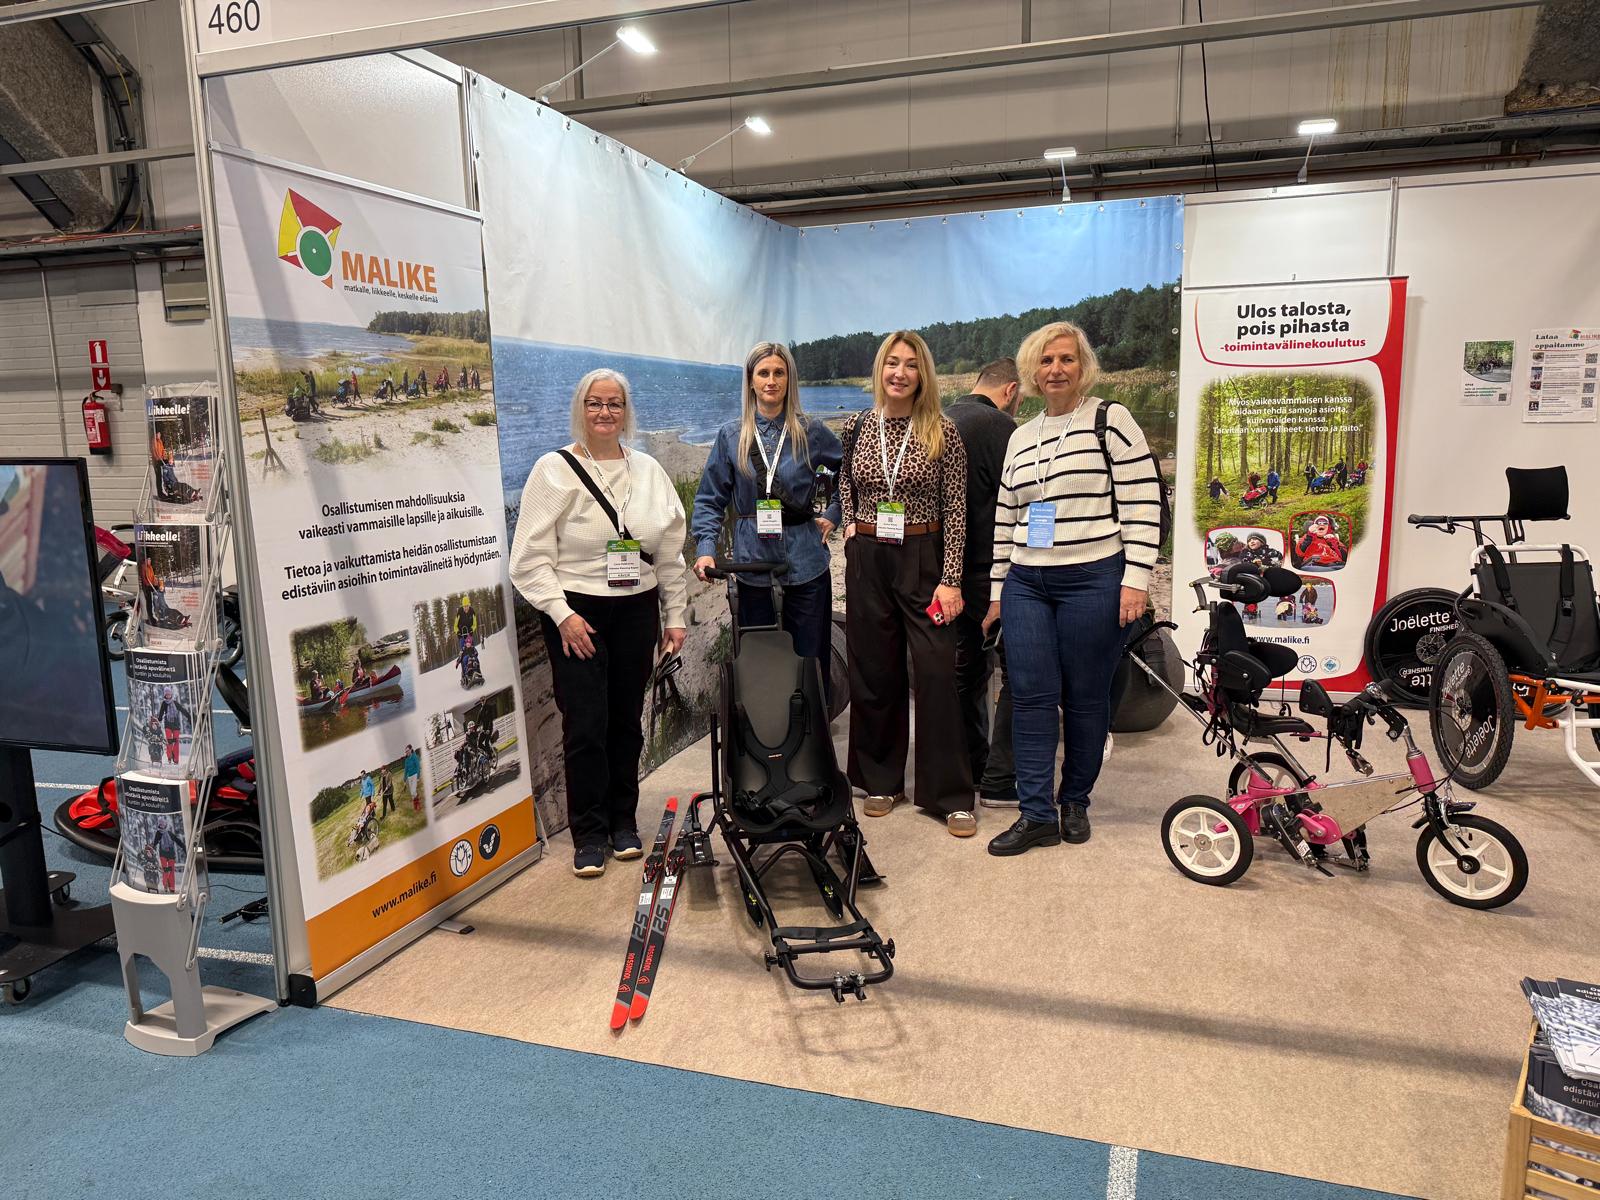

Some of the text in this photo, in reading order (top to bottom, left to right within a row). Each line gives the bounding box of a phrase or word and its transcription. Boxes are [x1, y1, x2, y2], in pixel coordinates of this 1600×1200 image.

[208, 0, 260, 34] 460
[342, 251, 437, 293] MALIKE
[344, 285, 438, 304] matkalle, liikkeelle, keskelle elämää
[1237, 302, 1351, 319] Ulos talosta,
[1237, 318, 1350, 340] pois pihasta
[1220, 338, 1366, 352] -toimintavälinekoulutus
[1252, 396, 1322, 406] vaikeavammaisen
[1324, 396, 1352, 404] kanssa
[1263, 406, 1286, 414] tehdä
[1288, 407, 1318, 416] samoja
[1330, 424, 1338, 433] ja
[322, 492, 465, 517] Osallistumisen mahdollisuuksia
[299, 506, 484, 540] vaikeasti vammaisille lapsille ja aikuisille.
[284, 534, 497, 580] Tietoa ja vaikuttamista heidän osallistumistaan
[281, 550, 502, 600] edistäviin asioihin toimintavälineitä hyödyntäen.
[1390, 612, 1450, 632] Joëlette
[1430, 623, 1460, 634] FINISHER
[372, 871, 437, 918] www.malike.fi
